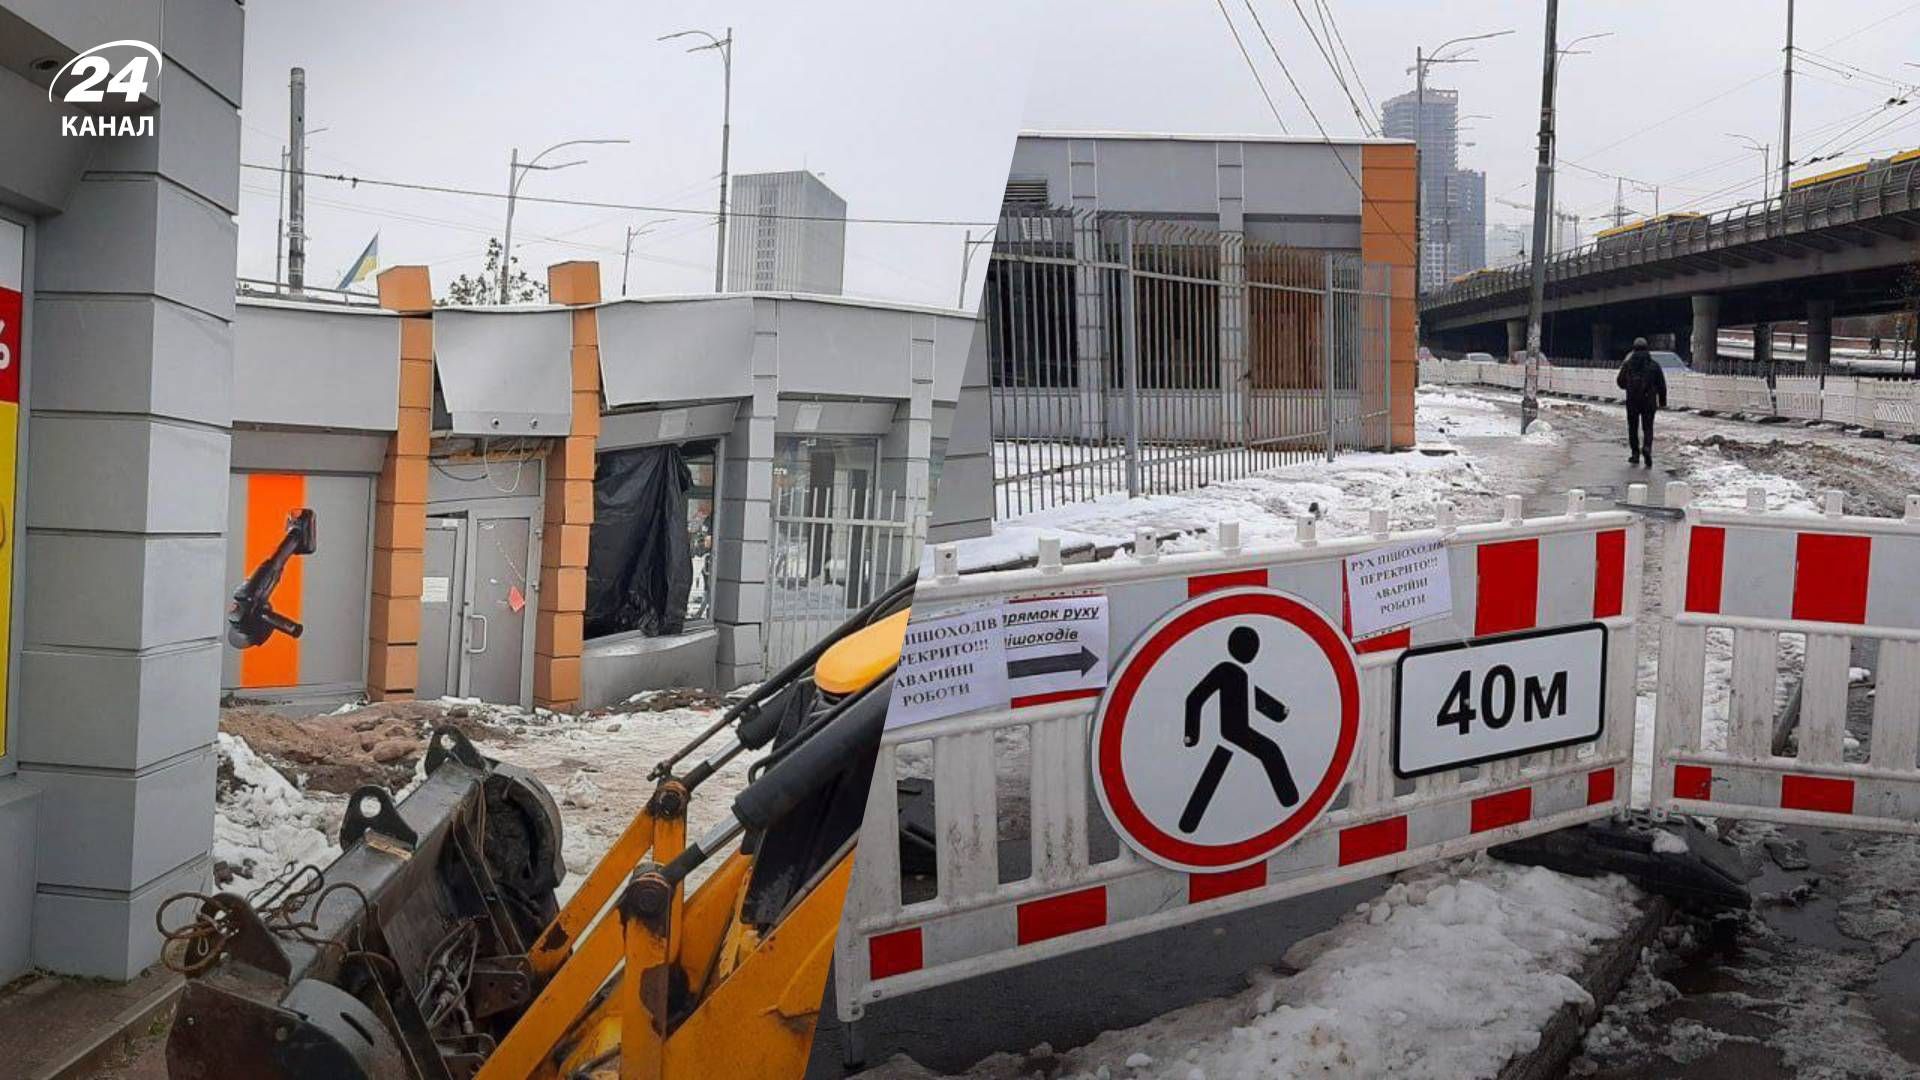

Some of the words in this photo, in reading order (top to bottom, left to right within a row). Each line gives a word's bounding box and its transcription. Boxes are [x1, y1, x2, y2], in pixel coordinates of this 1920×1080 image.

[1351, 558, 1375, 571] РУХ
[1063, 606, 1100, 621] руху
[1380, 594, 1425, 614] РОБОТИ
[895, 663, 974, 689] АВАРІЙНІ
[903, 683, 970, 707] РОБОТИ
